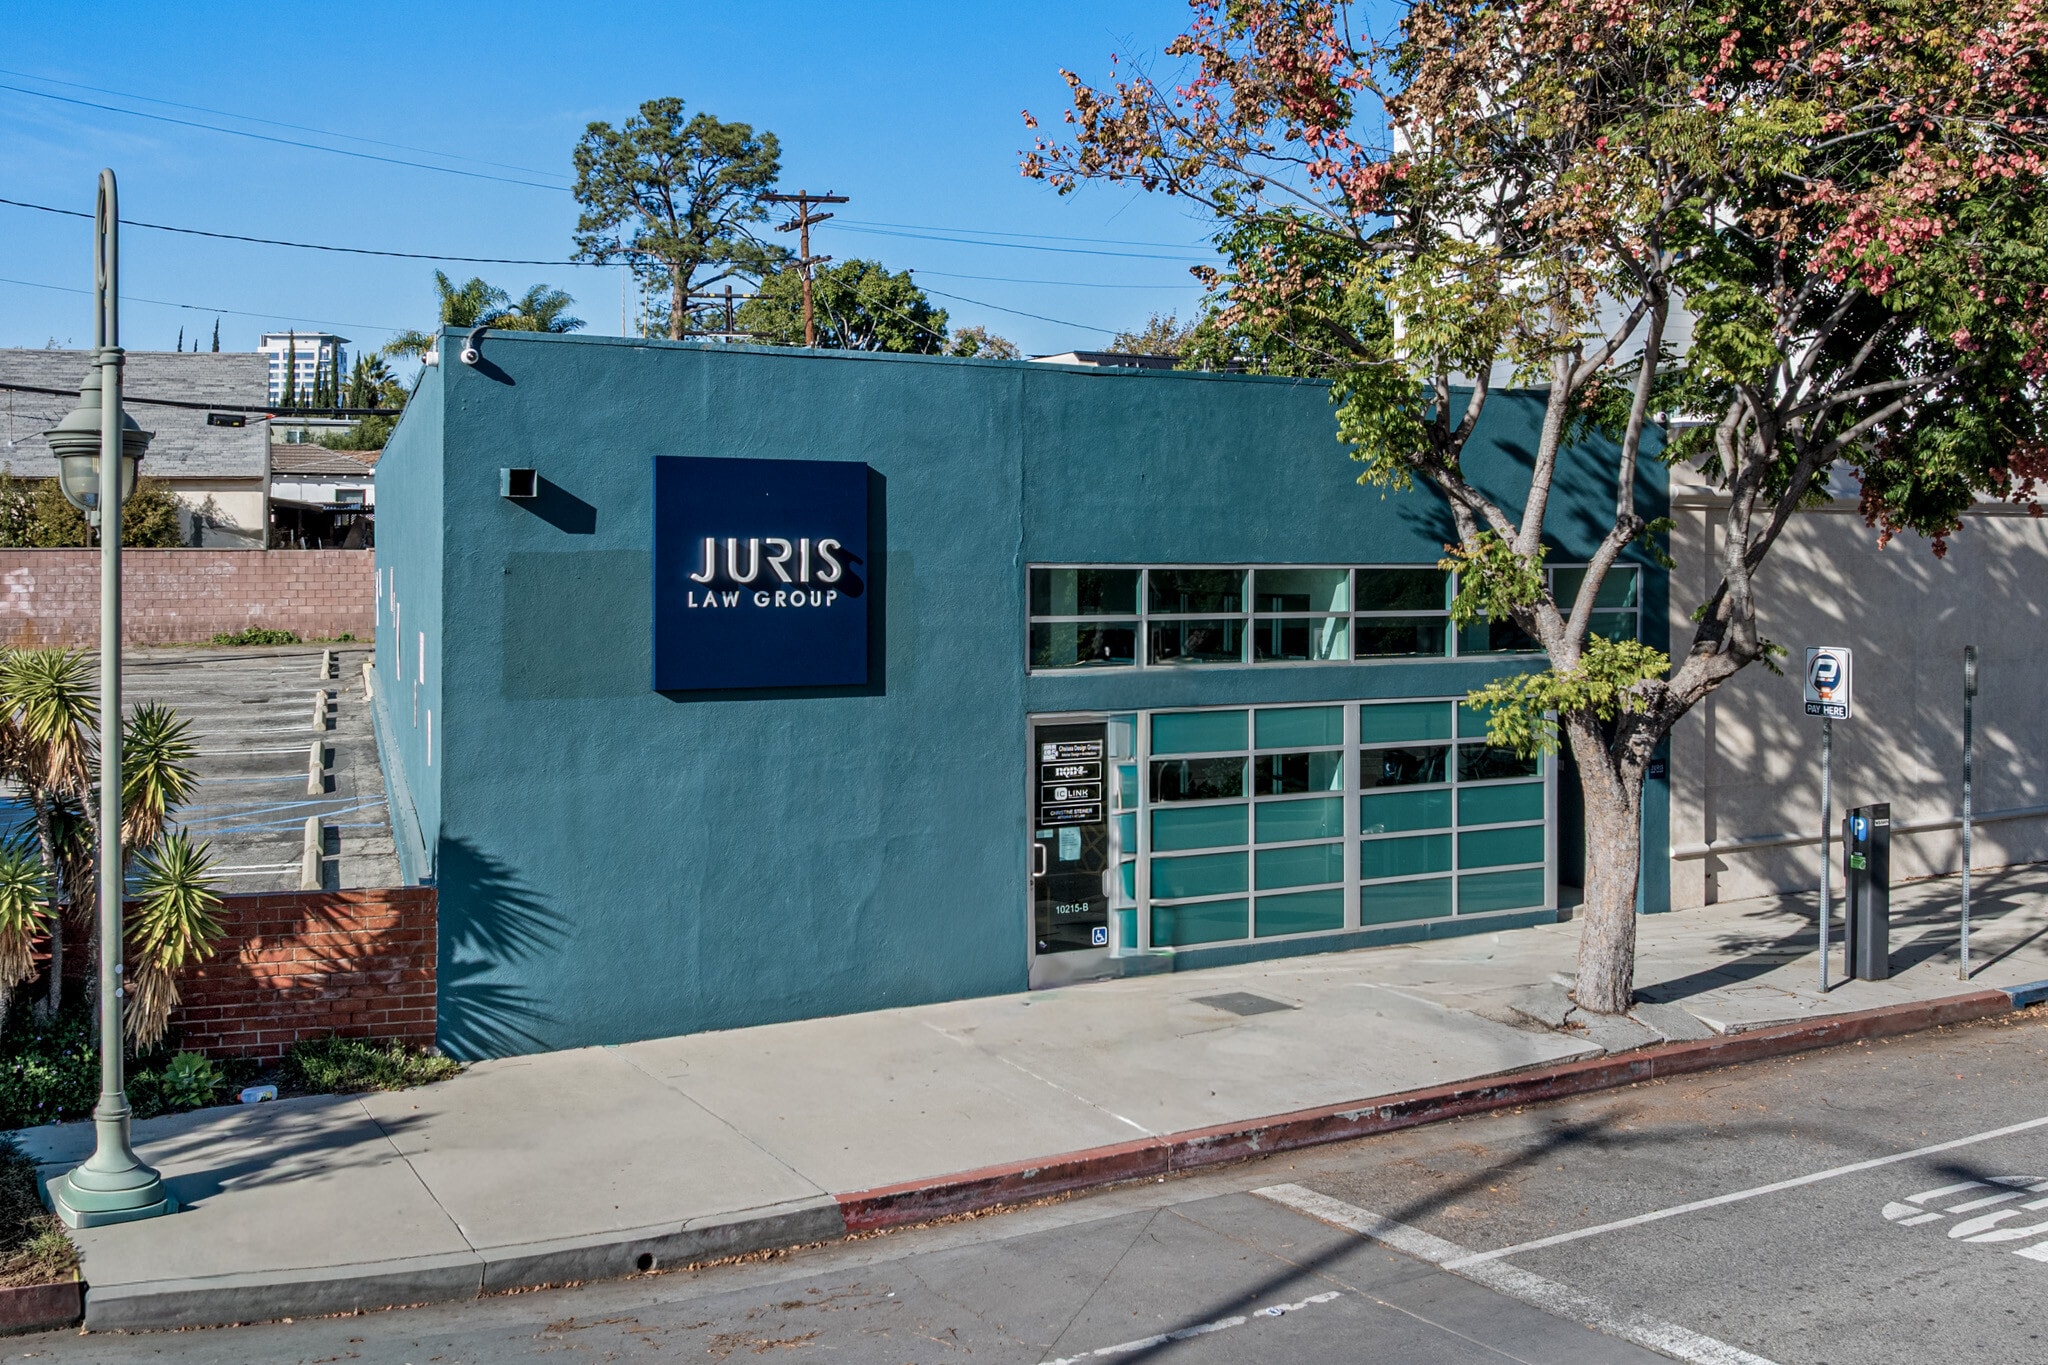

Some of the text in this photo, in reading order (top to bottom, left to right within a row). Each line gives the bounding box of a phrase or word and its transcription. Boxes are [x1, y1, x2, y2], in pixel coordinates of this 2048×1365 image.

[690, 537, 842, 583] JURIS
[688, 590, 838, 608] LAW GROUP
[1807, 704, 1844, 716] PAY HERE
[1056, 903, 1089, 914] 10215-B
